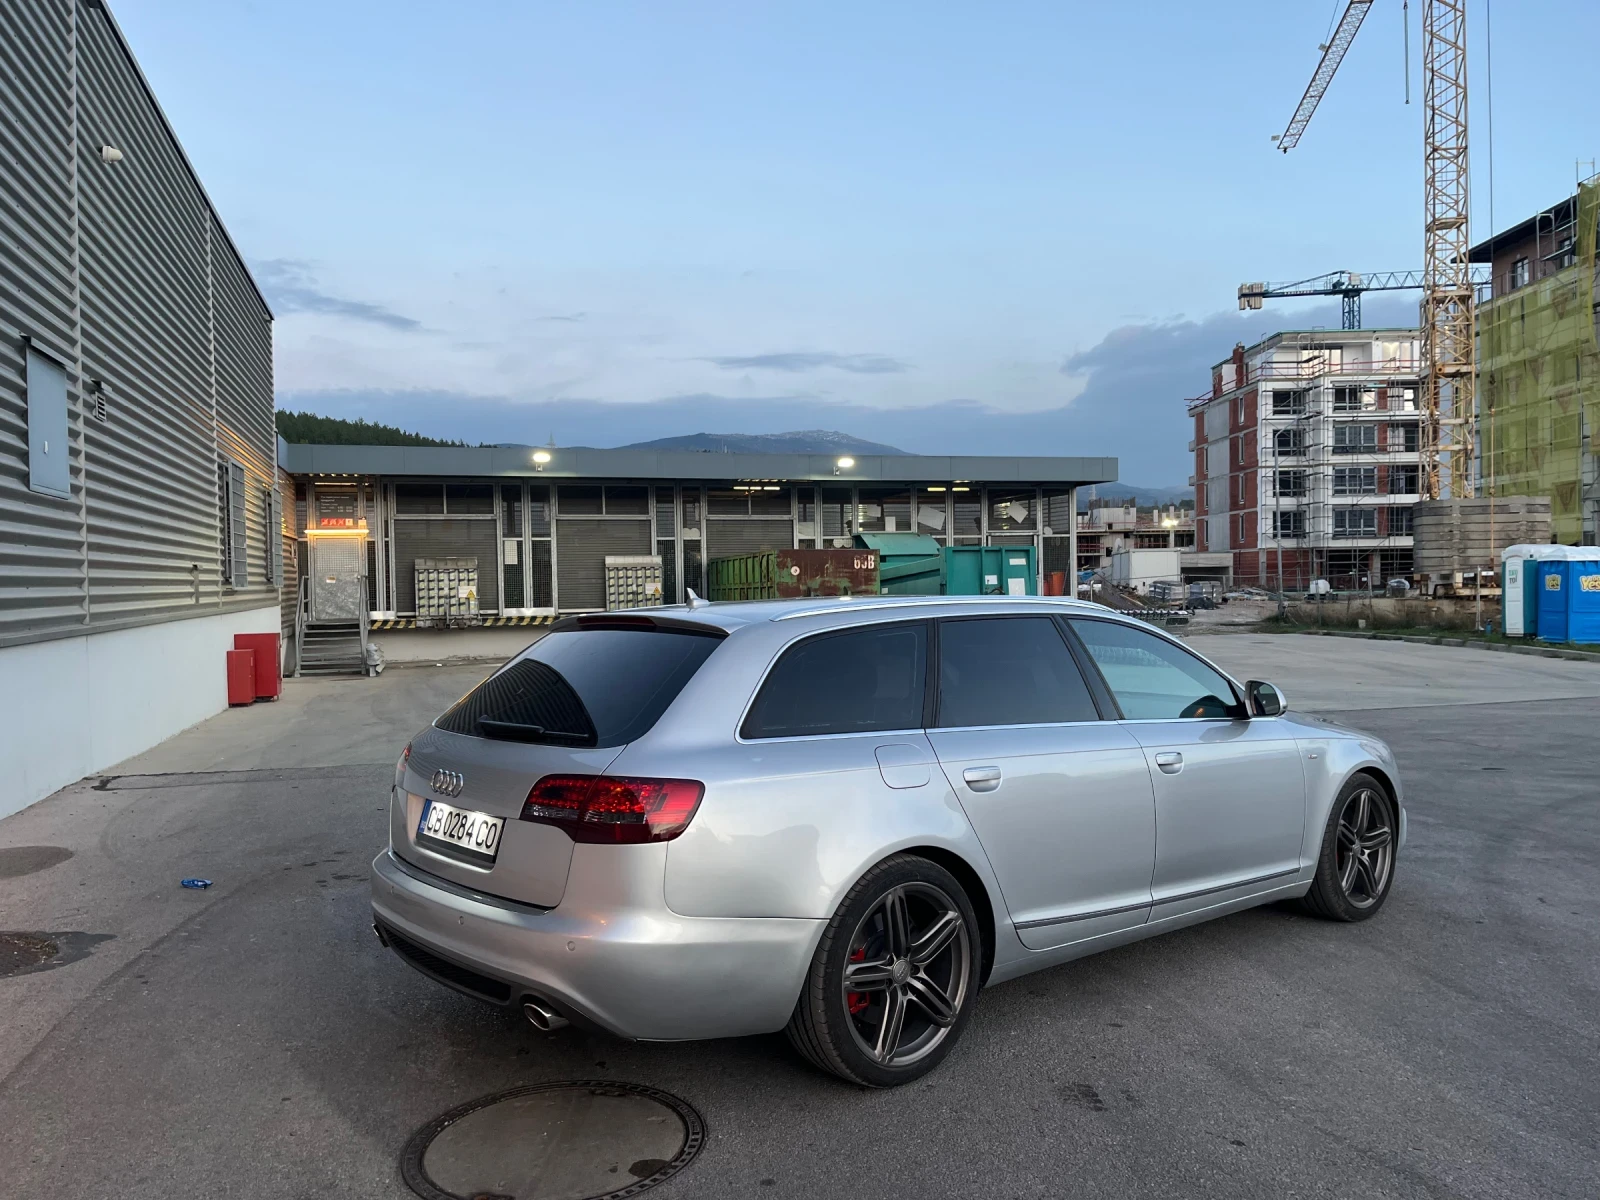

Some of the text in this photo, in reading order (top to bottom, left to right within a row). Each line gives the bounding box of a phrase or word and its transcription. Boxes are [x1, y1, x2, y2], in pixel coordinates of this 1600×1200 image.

[427, 806, 498, 849] CB 0284 CO
